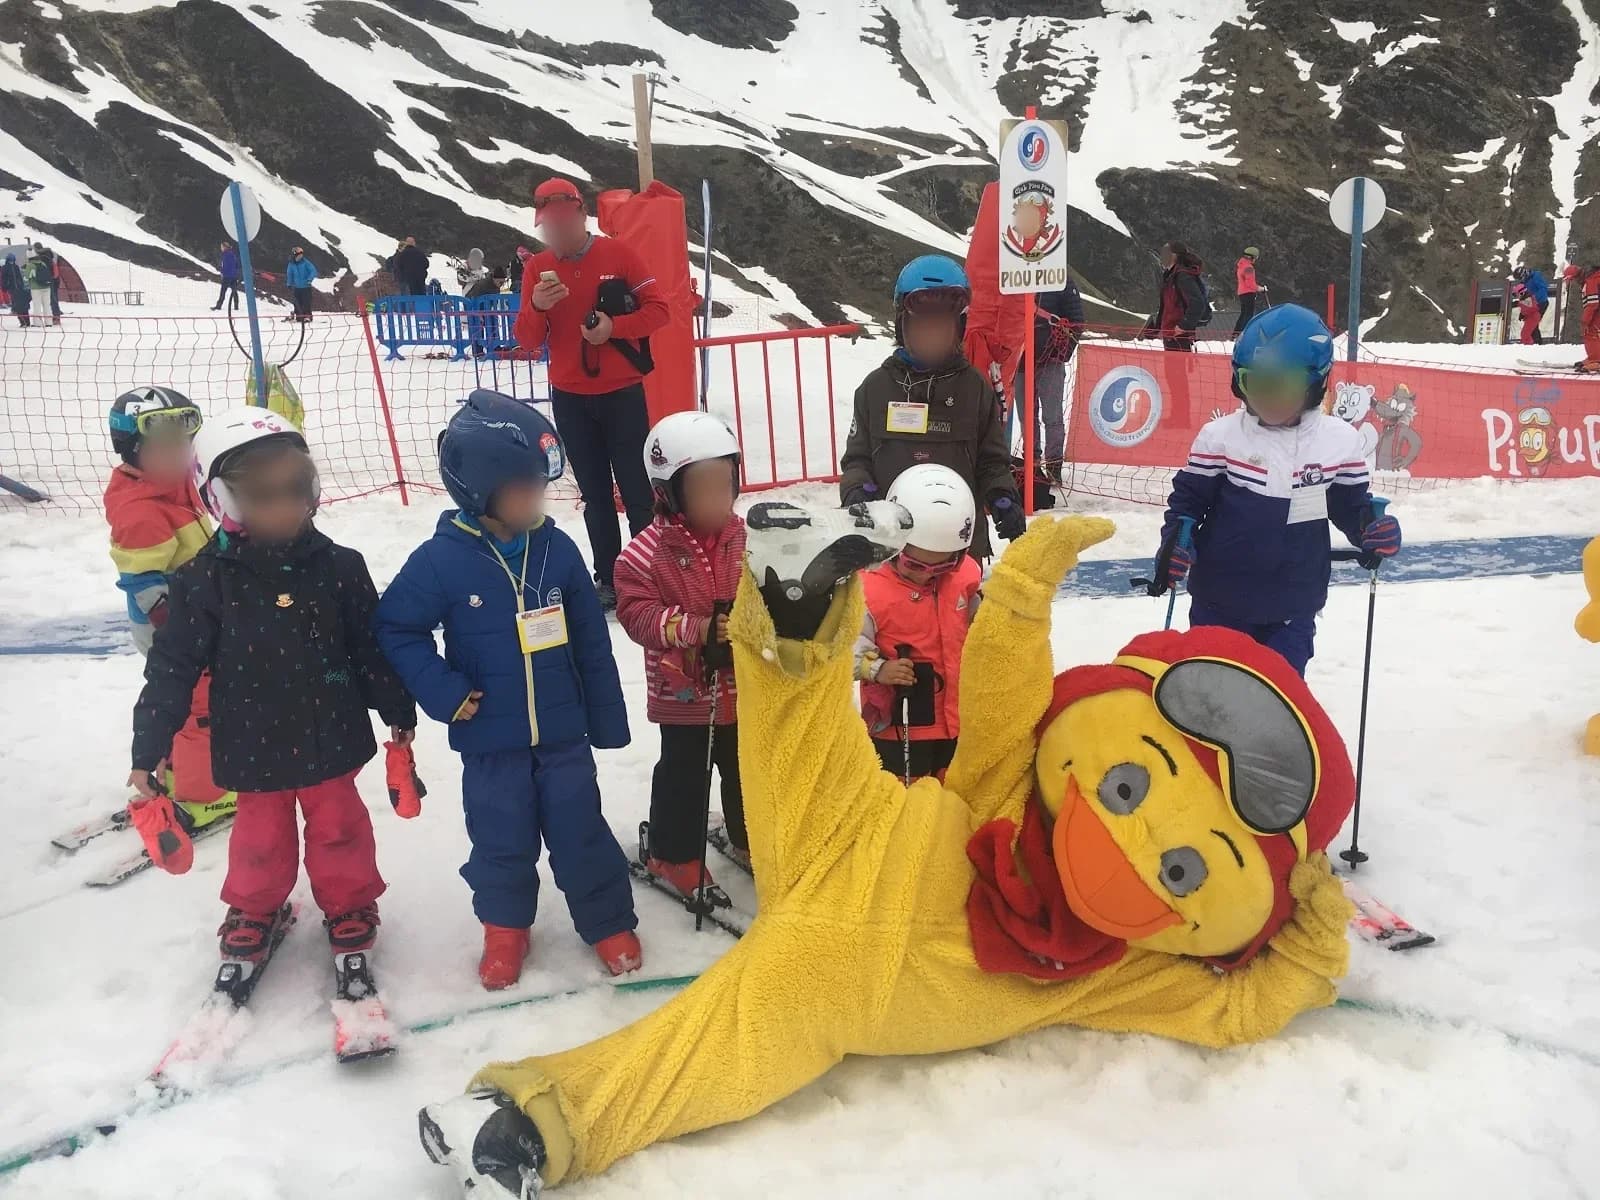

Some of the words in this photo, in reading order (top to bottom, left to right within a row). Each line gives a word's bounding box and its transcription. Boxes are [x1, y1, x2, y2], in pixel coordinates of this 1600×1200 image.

[1001, 270, 1031, 288] PIOU
[1035, 268, 1065, 286] PIOU
[132, 405, 141, 416] 3
